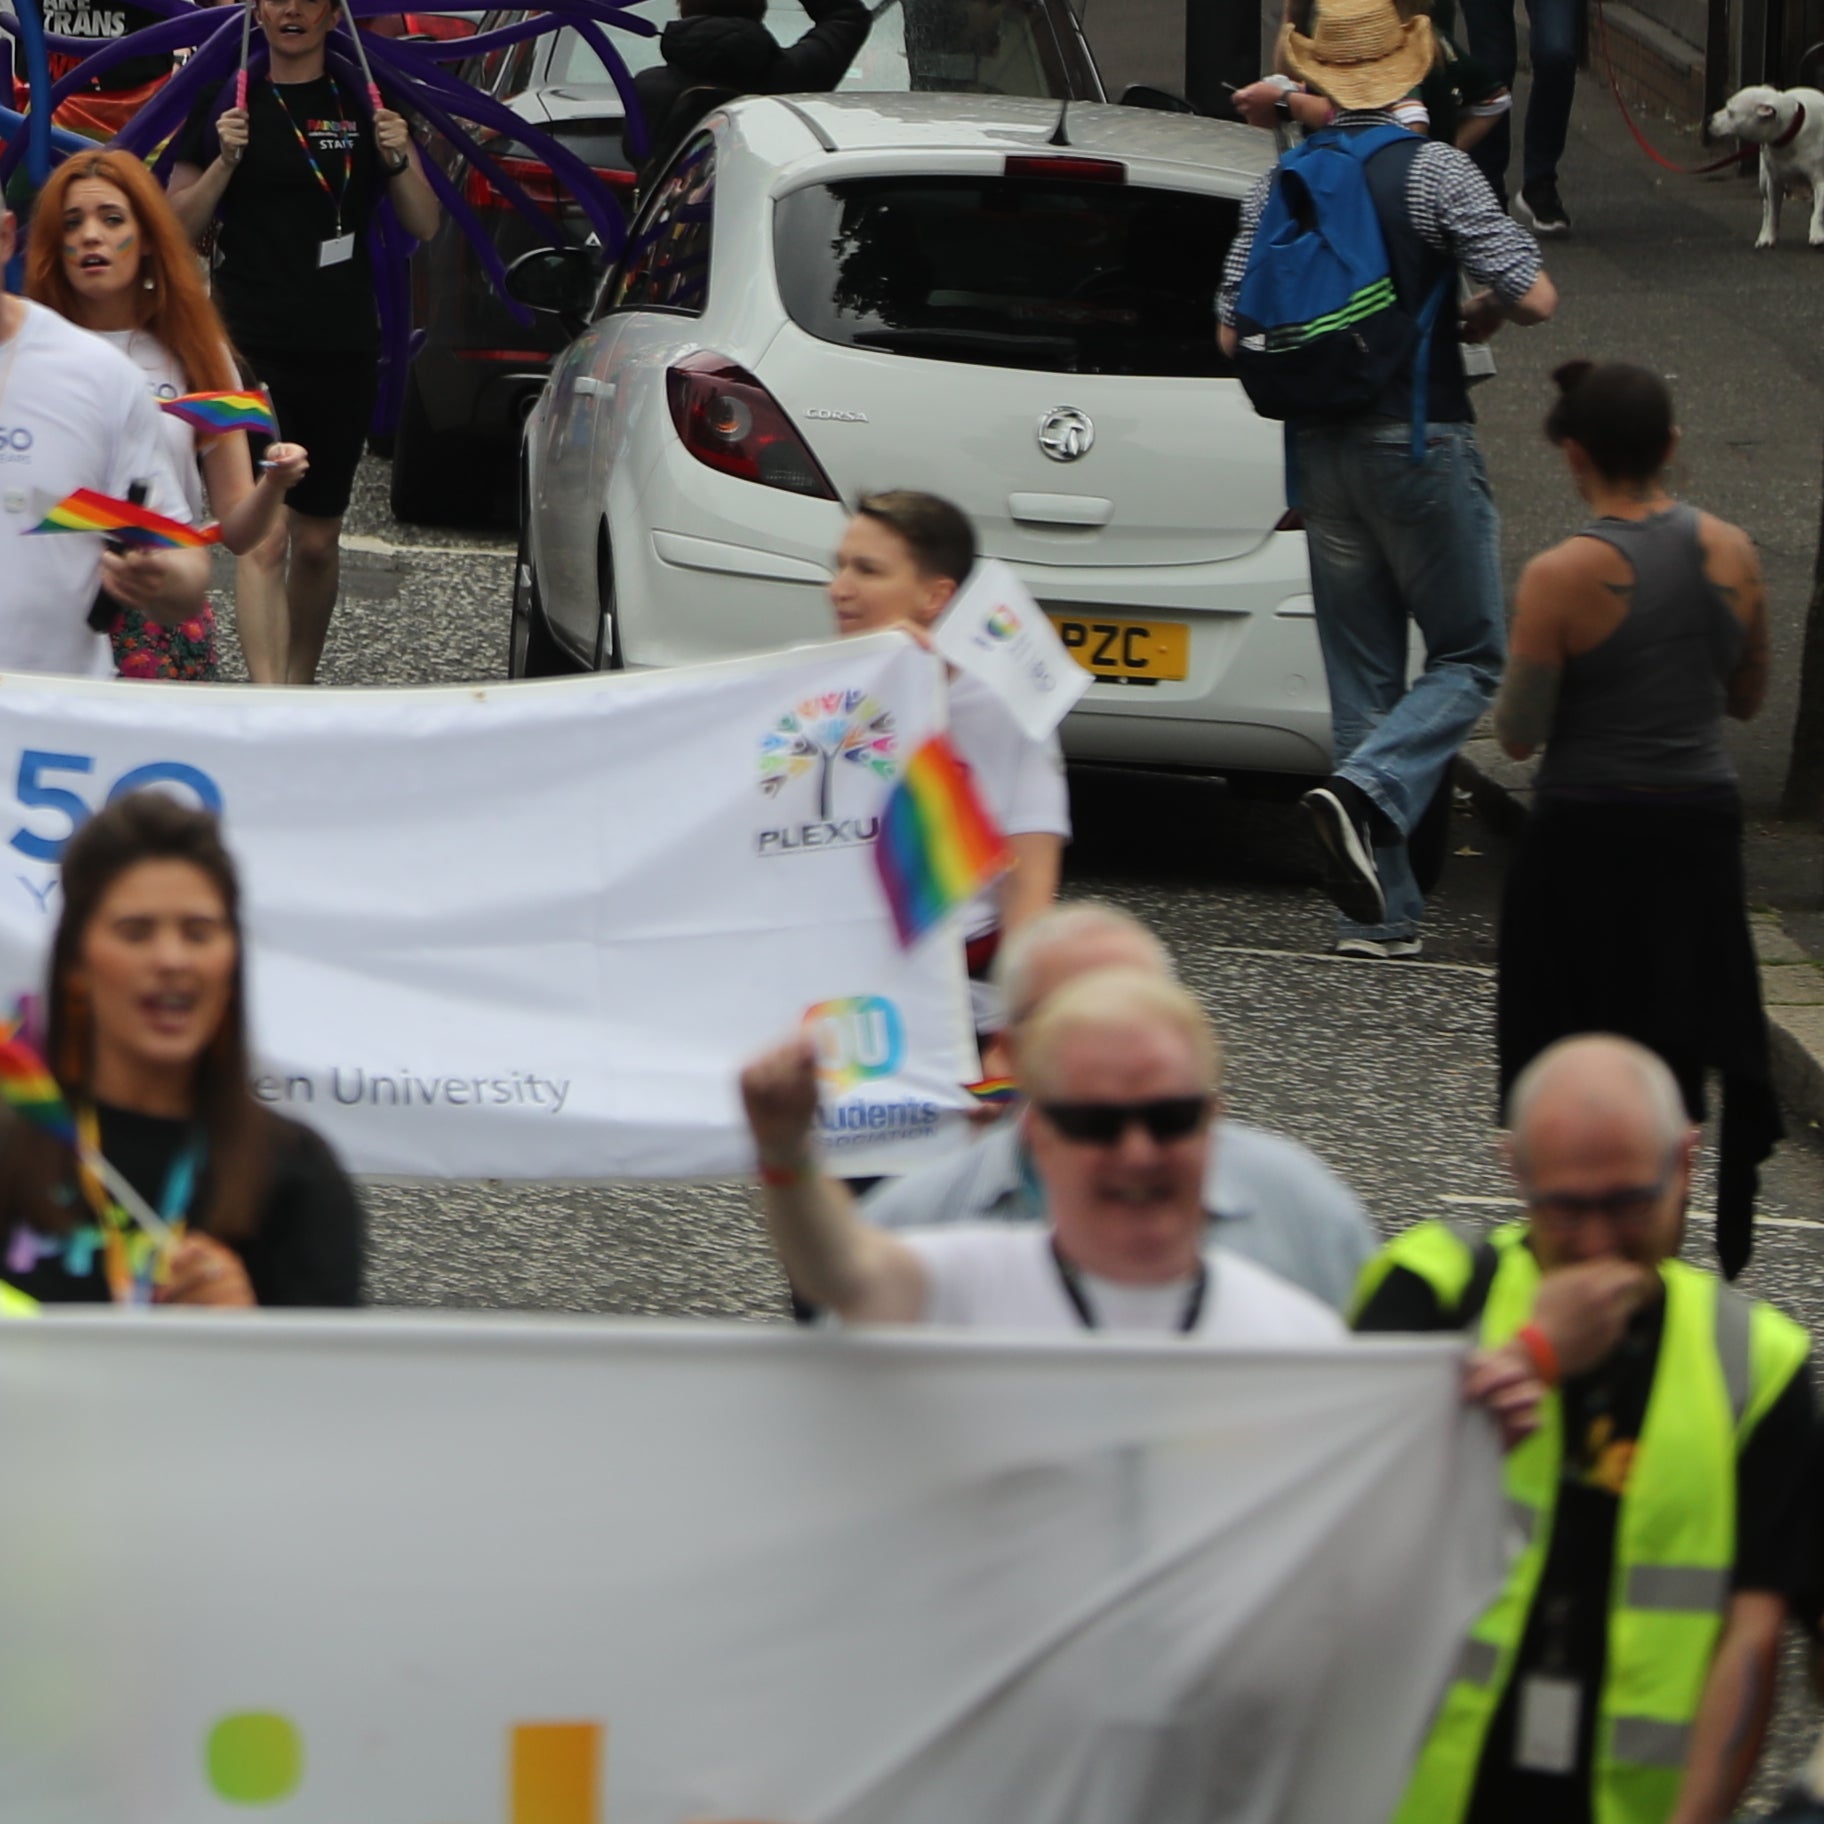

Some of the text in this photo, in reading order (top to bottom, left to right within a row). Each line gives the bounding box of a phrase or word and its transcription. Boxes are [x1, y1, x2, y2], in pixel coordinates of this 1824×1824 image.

[43, 9, 126, 38] TRANS
[806, 408, 869, 424] CORSA
[1060, 621, 1151, 669] PZC
[757, 815, 881, 853] PLEXU
[254, 1065, 571, 1114] en University
[816, 1096, 940, 1132] udents
